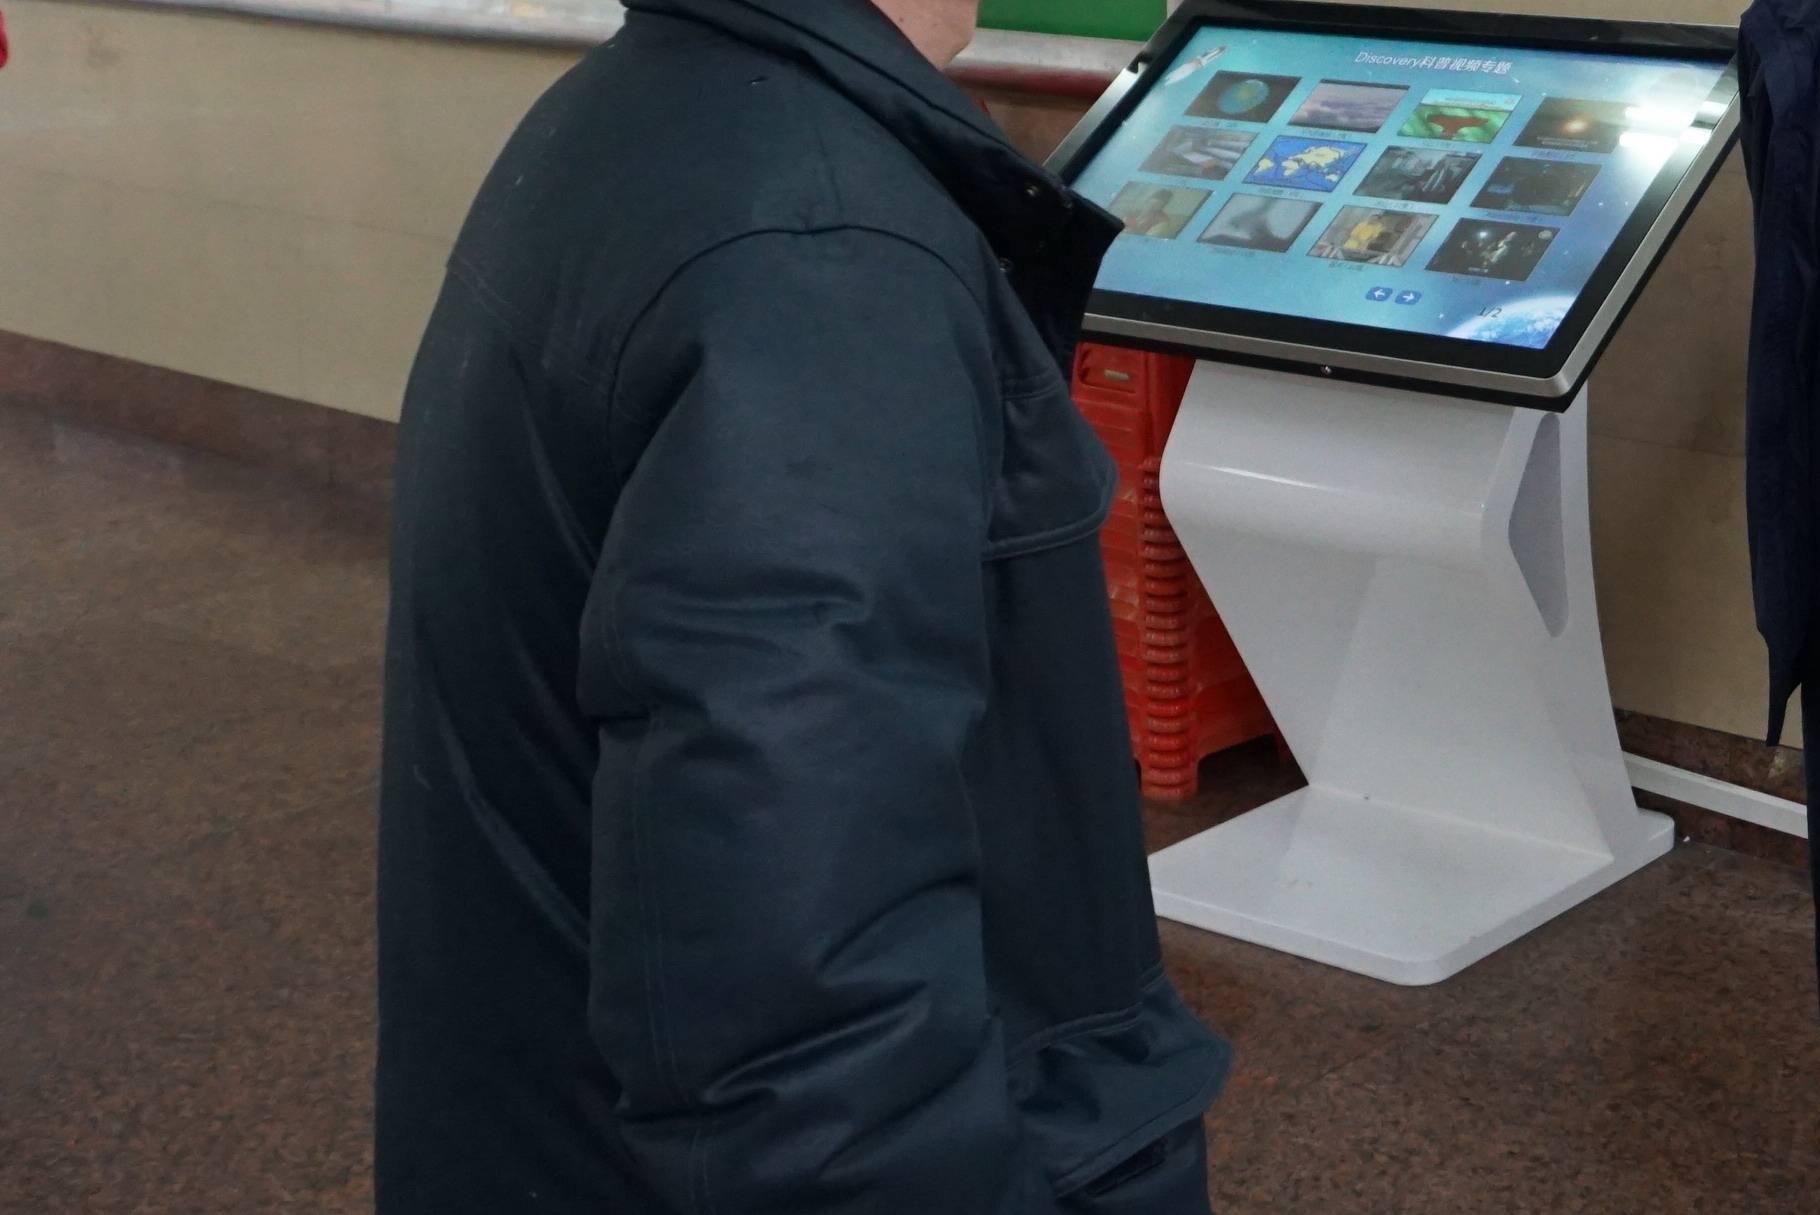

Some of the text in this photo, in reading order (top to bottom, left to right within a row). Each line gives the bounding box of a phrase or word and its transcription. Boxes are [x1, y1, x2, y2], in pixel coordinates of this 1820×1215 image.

[1355, 51, 1514, 75] Discovery科普视频专题
[1478, 306, 1503, 320] 1/2
